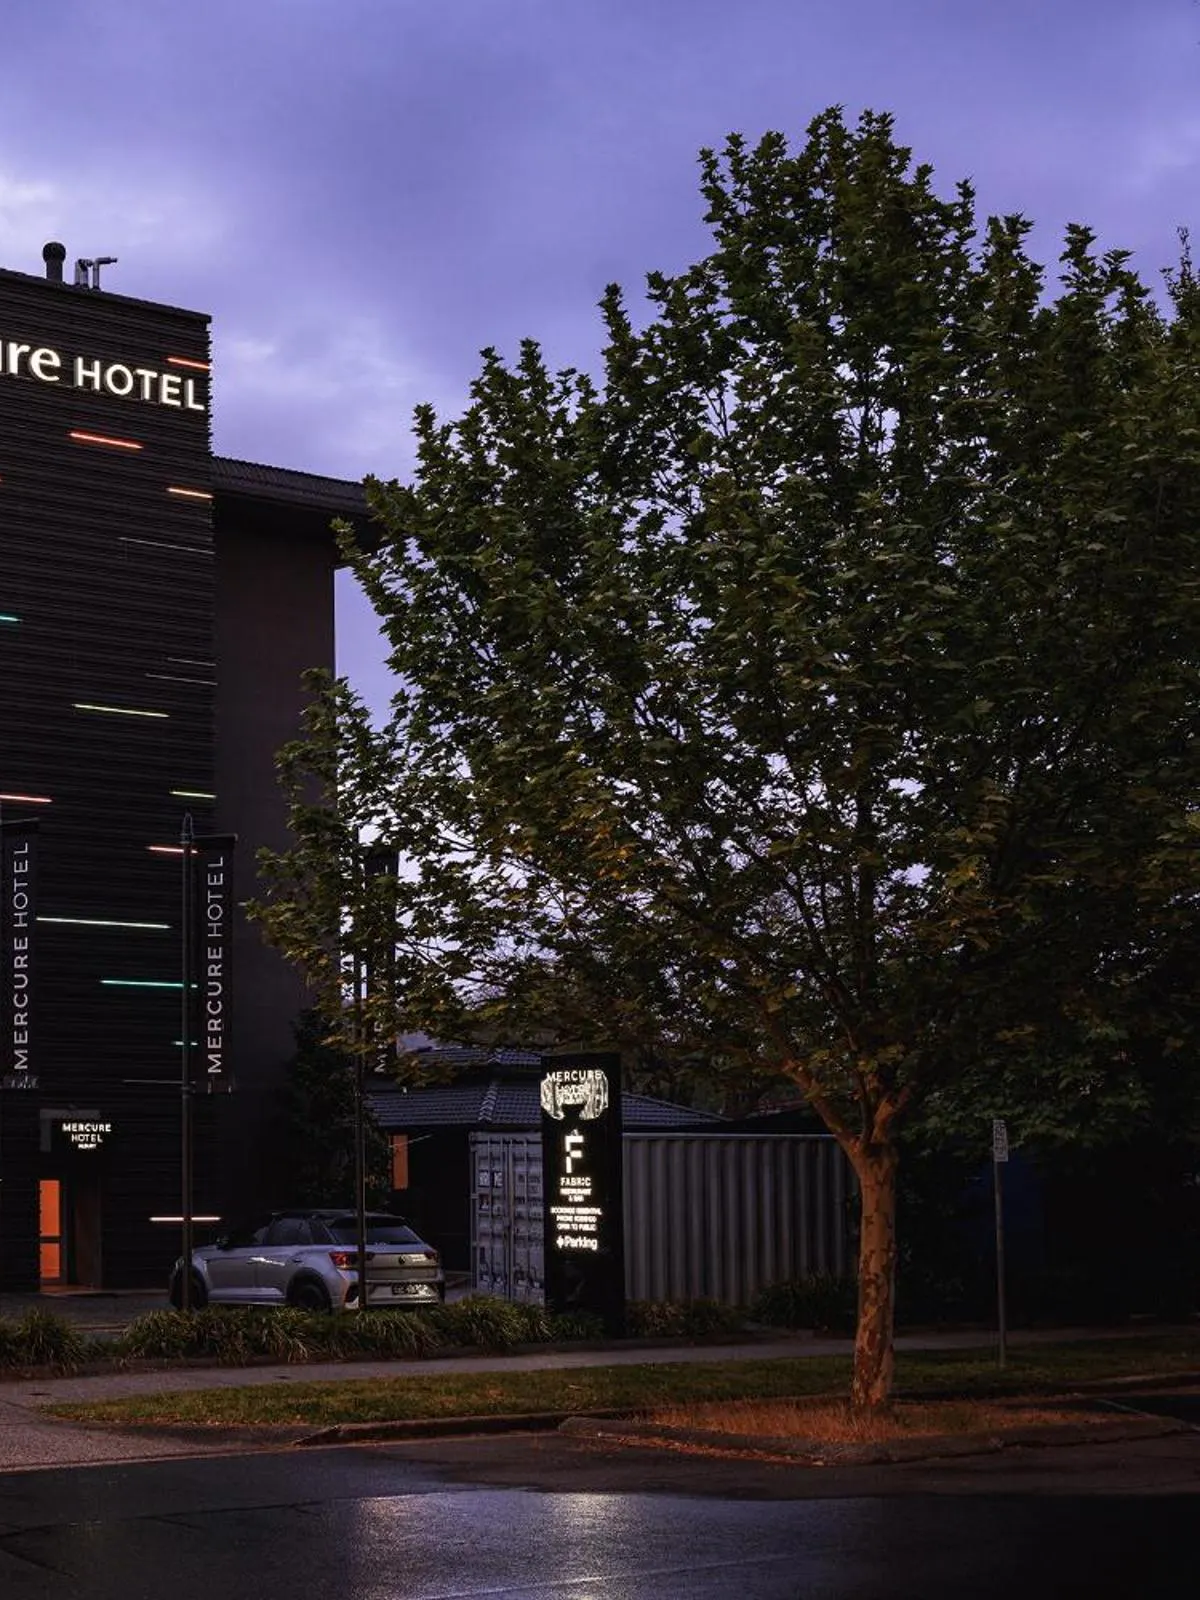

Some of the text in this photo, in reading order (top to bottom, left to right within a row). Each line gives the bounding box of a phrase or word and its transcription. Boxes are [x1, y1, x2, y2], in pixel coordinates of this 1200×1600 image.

[75, 356, 206, 412] HOTEL
[13, 841, 29, 1070] MERCURE HOTEL
[207, 856, 224, 1073] MERCURE HOTEL
[62, 1122, 112, 1132] MERCURE
[71, 1133, 103, 1143] HOTEL
[564, 1235, 598, 1251] Parking
